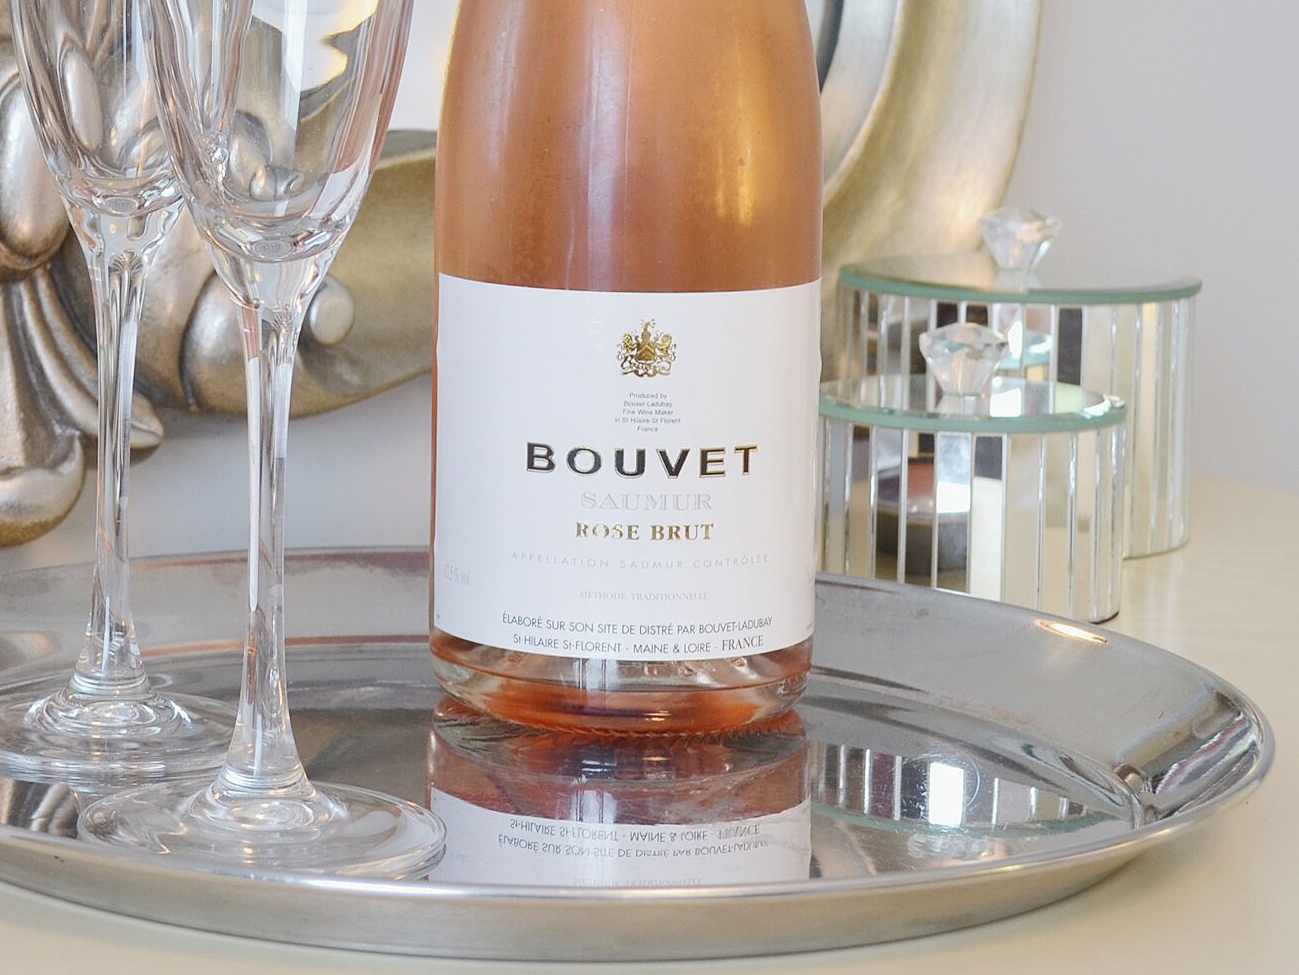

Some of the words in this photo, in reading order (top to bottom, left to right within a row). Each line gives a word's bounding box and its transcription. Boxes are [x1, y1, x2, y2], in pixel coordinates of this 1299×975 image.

[526, 441, 758, 479] BOUVET
[579, 491, 714, 512] SAUMUR
[574, 521, 640, 541] ROSE
[649, 522, 715, 541] BRUT
[510, 550, 610, 569] APPELLATION
[619, 559, 684, 570] SAUMUR
[502, 611, 543, 629] ÉLABORÉ
[546, 619, 566, 631] SUR
[568, 621, 594, 633] SON
[597, 623, 619, 635] SITE
[621, 625, 636, 635] DE
[639, 623, 674, 636] DISTRÉ
[677, 624, 697, 635] PAR
[699, 616, 773, 635] BOUVET-LADUBAY
[513, 633, 560, 649] St-HILAIRE
[562, 639, 623, 654] St-FLORENT
[633, 643, 669, 654] MAINE
[672, 643, 681, 654] &
[683, 642, 712, 654] LOIRE
[721, 635, 765, 652] FRANCE
